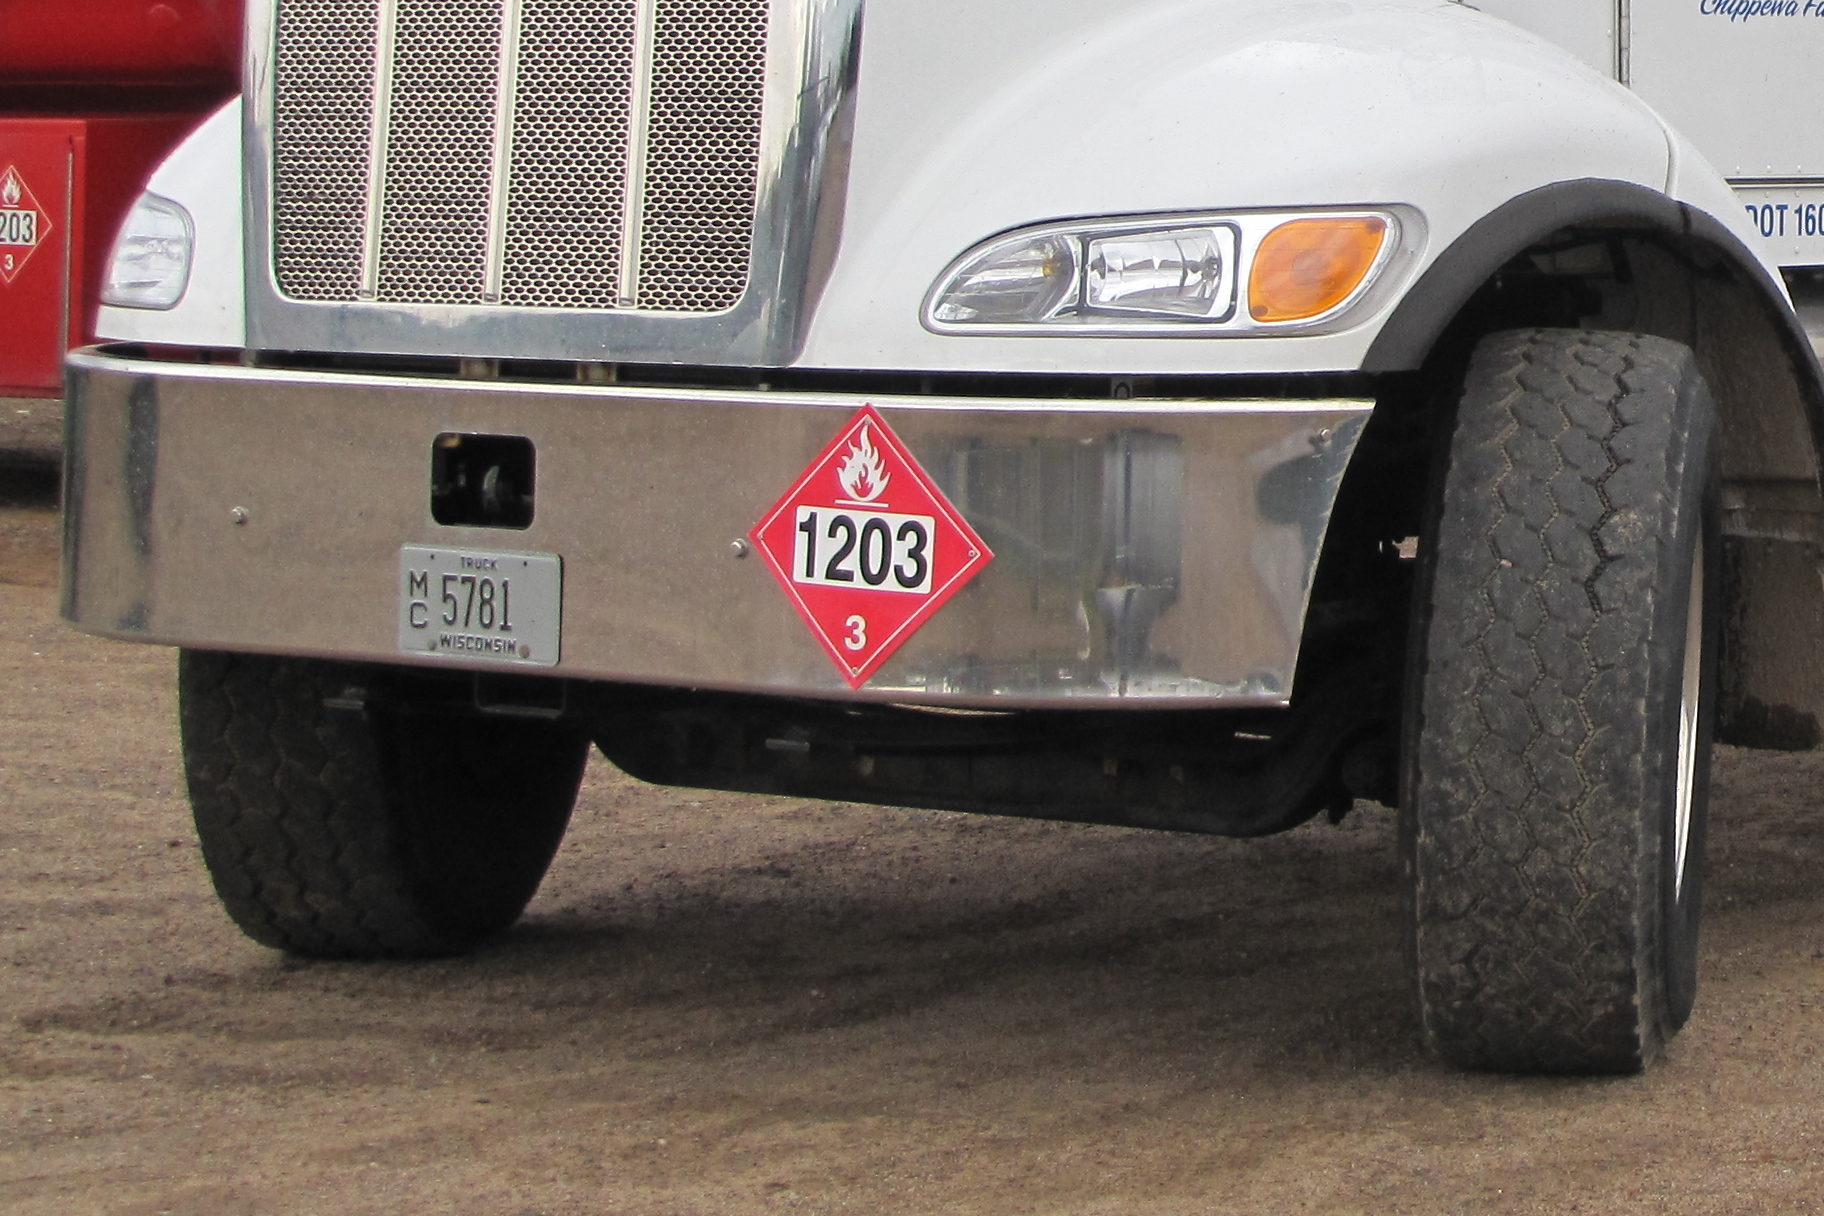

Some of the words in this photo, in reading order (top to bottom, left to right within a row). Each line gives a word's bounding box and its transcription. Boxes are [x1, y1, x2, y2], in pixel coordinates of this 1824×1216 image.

[0, 211, 34, 243] 203
[4, 253, 15, 270] 3
[461, 556, 498, 570] TRUCK
[798, 510, 929, 589] 1203
[442, 573, 513, 632] 5781
[440, 634, 517, 654] WISCONSIN
[844, 615, 866, 651] 3
